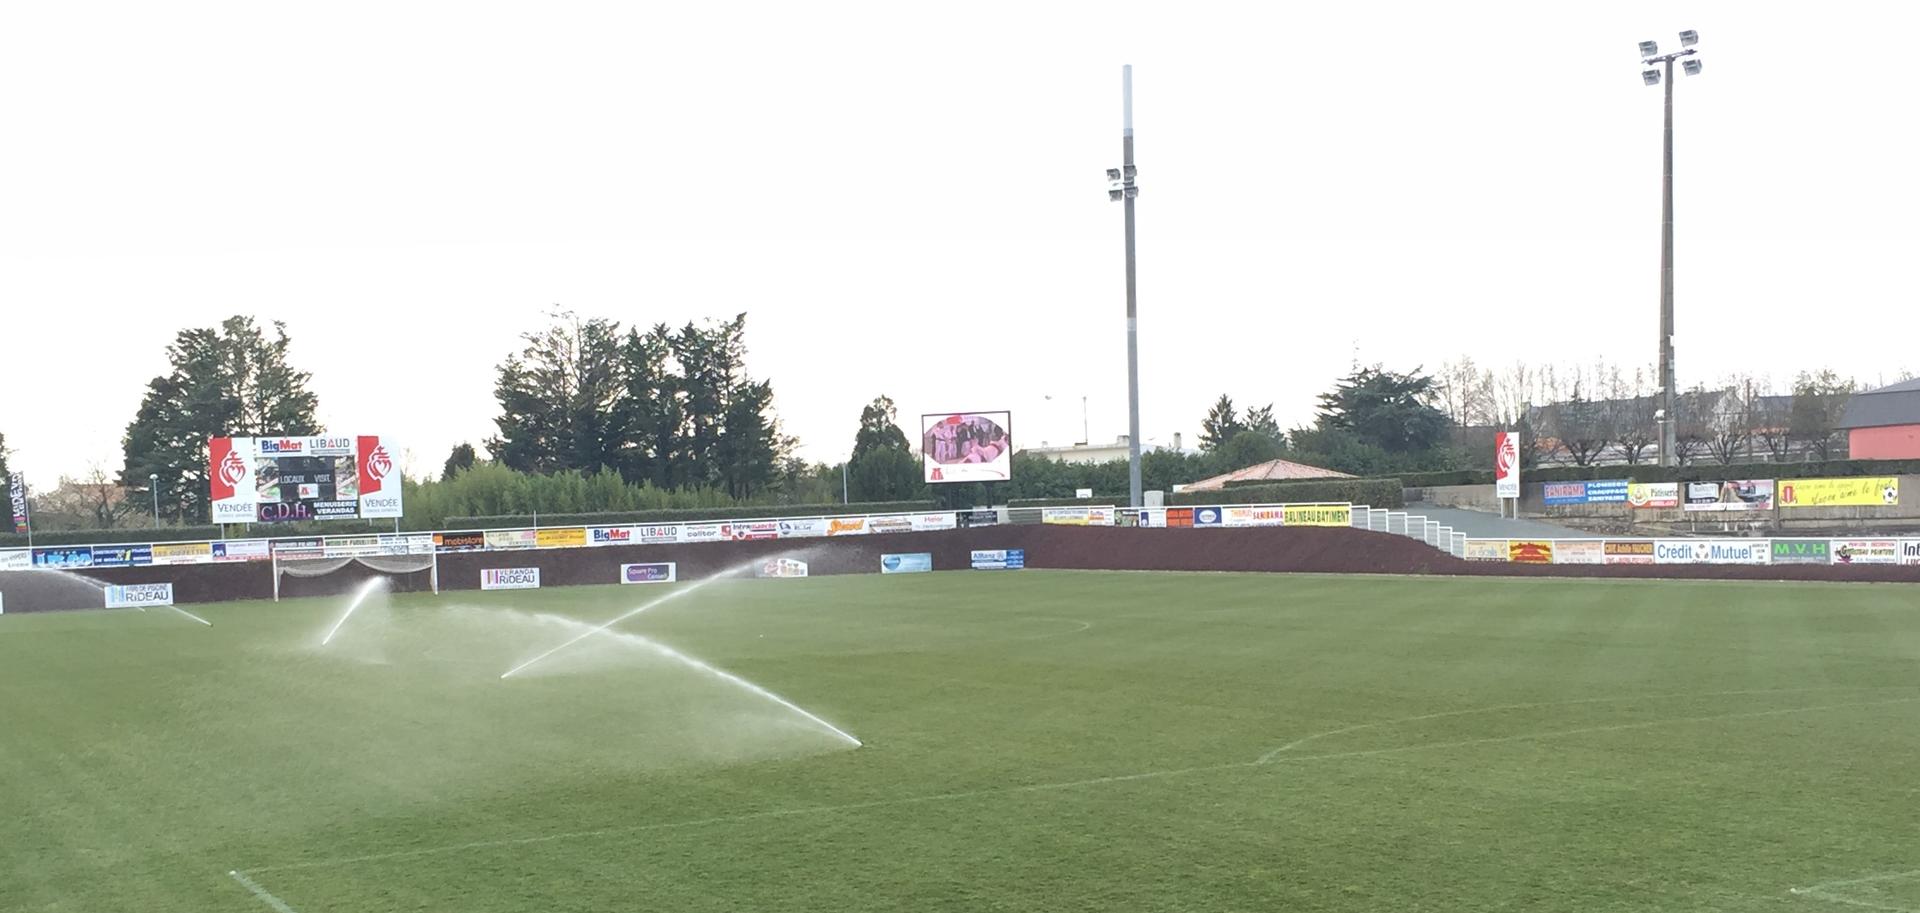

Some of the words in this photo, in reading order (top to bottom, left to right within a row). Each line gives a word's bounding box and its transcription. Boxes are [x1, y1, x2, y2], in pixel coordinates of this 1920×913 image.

[261, 440, 302, 452] BigMat
[309, 438, 350, 449] LIBAUD
[217, 501, 253, 513] VENDÉE
[365, 498, 398, 507] VENDÉE
[593, 528, 630, 541] BigMat
[641, 527, 677, 537] LIBAUD
[1657, 543, 1692, 559] Crédit
[1711, 545, 1752, 559] Mutuel
